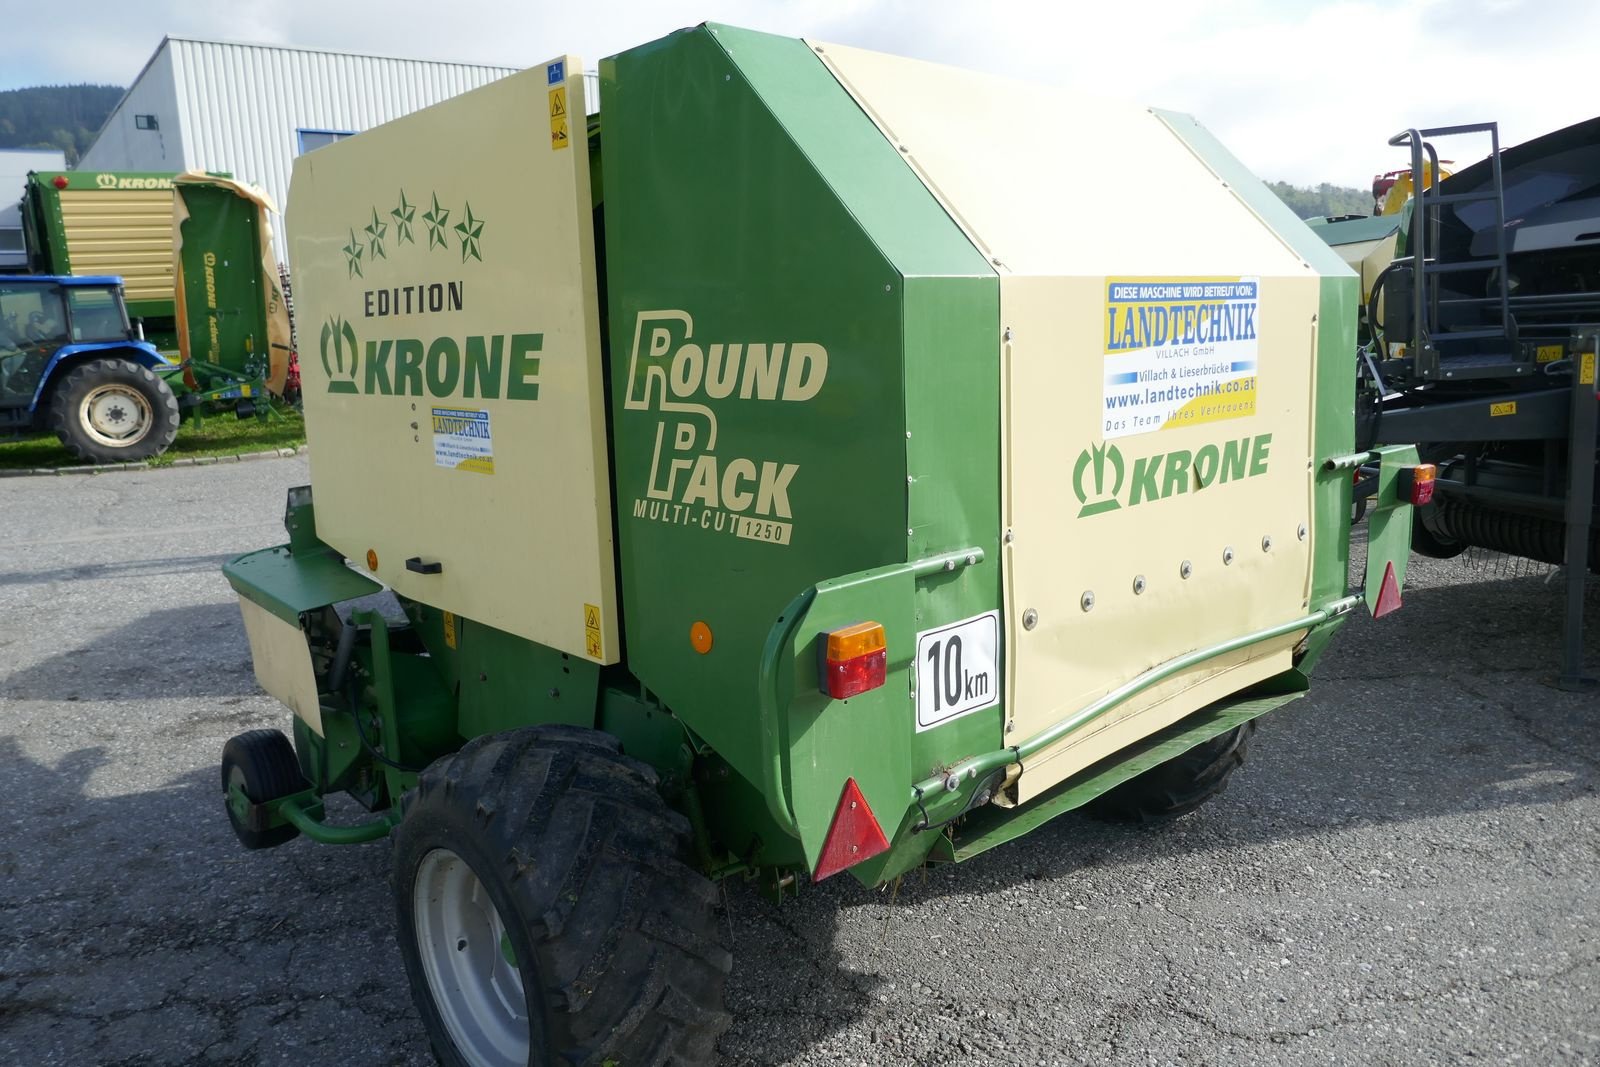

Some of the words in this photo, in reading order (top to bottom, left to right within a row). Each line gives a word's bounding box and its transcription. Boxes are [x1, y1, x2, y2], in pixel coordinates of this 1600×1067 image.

[205, 266, 217, 310] KRONE
[364, 280, 464, 318] EDITION
[1114, 286, 1138, 299] DIESE
[1139, 285, 1182, 298] MASCHINE
[1183, 285, 1203, 297] WIRD
[1204, 285, 1234, 297] BETREUT
[1235, 284, 1253, 296] VON:
[1107, 302, 1257, 350] LANDTECHNIK
[364, 332, 544, 401] KRONE
[624, 309, 829, 411] ROUND
[1139, 371, 1168, 383] Villach
[1170, 369, 1177, 379] &
[1179, 364, 1230, 378] Lieserbrücke
[1155, 348, 1190, 360] VILLACH
[1192, 346, 1215, 356] GmbH
[1105, 376, 1255, 409] www.landtechnik.co.at
[431, 416, 491, 439] LANDTECHNIK
[1105, 420, 1126, 432] Das
[1133, 414, 1161, 427] Team
[1167, 408, 1195, 421] Ihres
[1200, 400, 1255, 417] Vertrauens
[646, 402, 801, 520] PACK
[1128, 432, 1273, 507] KRONE
[633, 498, 739, 534] MULTI-CUT
[745, 520, 783, 541] 1250
[927, 634, 963, 713] 10
[964, 668, 989, 701] km
